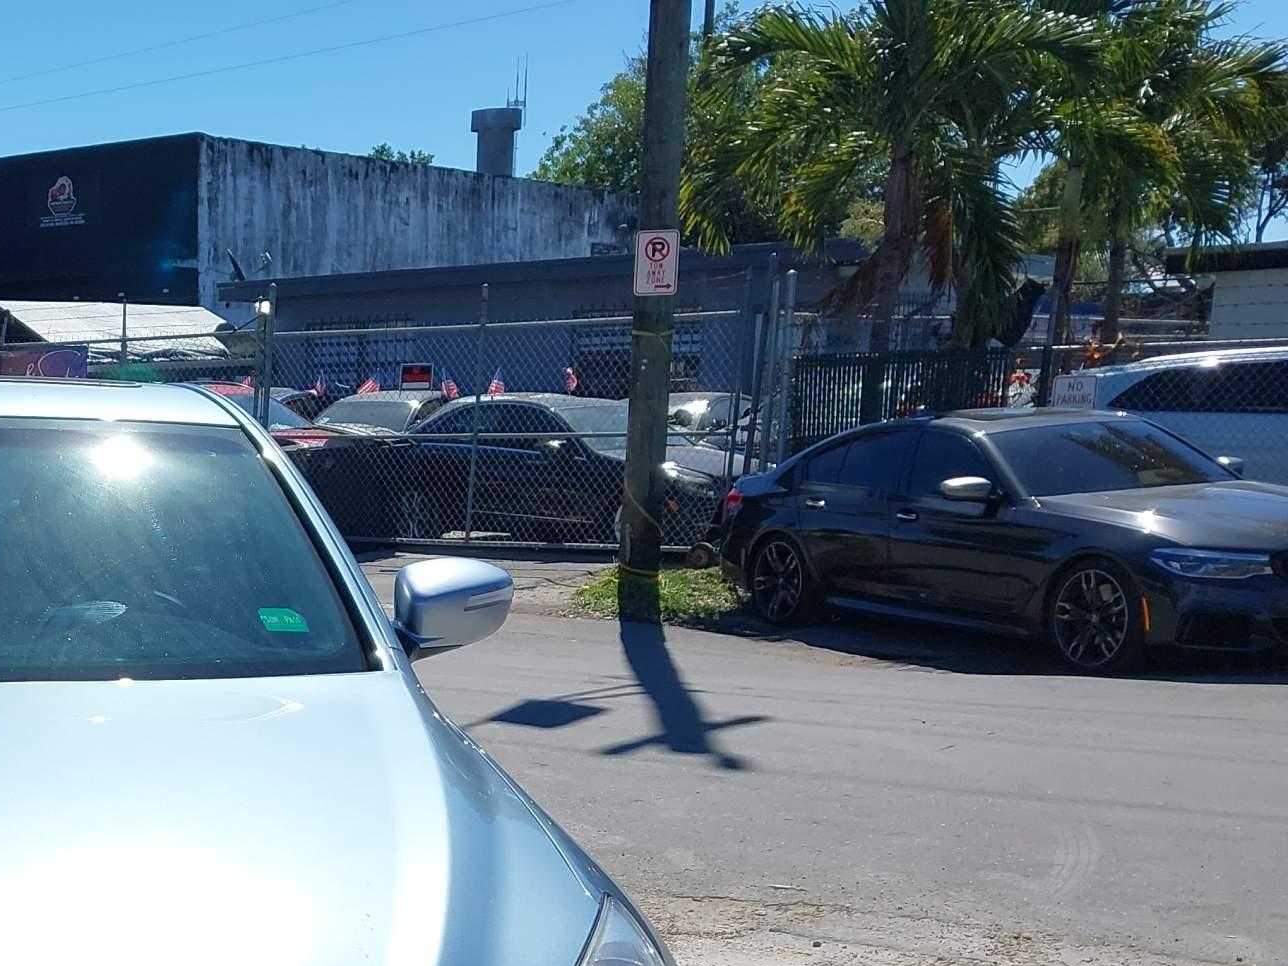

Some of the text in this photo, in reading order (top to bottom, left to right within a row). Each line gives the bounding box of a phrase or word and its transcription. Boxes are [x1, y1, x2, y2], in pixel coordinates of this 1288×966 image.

[649, 262, 663, 270] TOW
[646, 270, 665, 278] AWAY
[646, 277, 664, 285] ZONE
[1067, 380, 1084, 392] NO
[1055, 392, 1093, 406] PARKING
